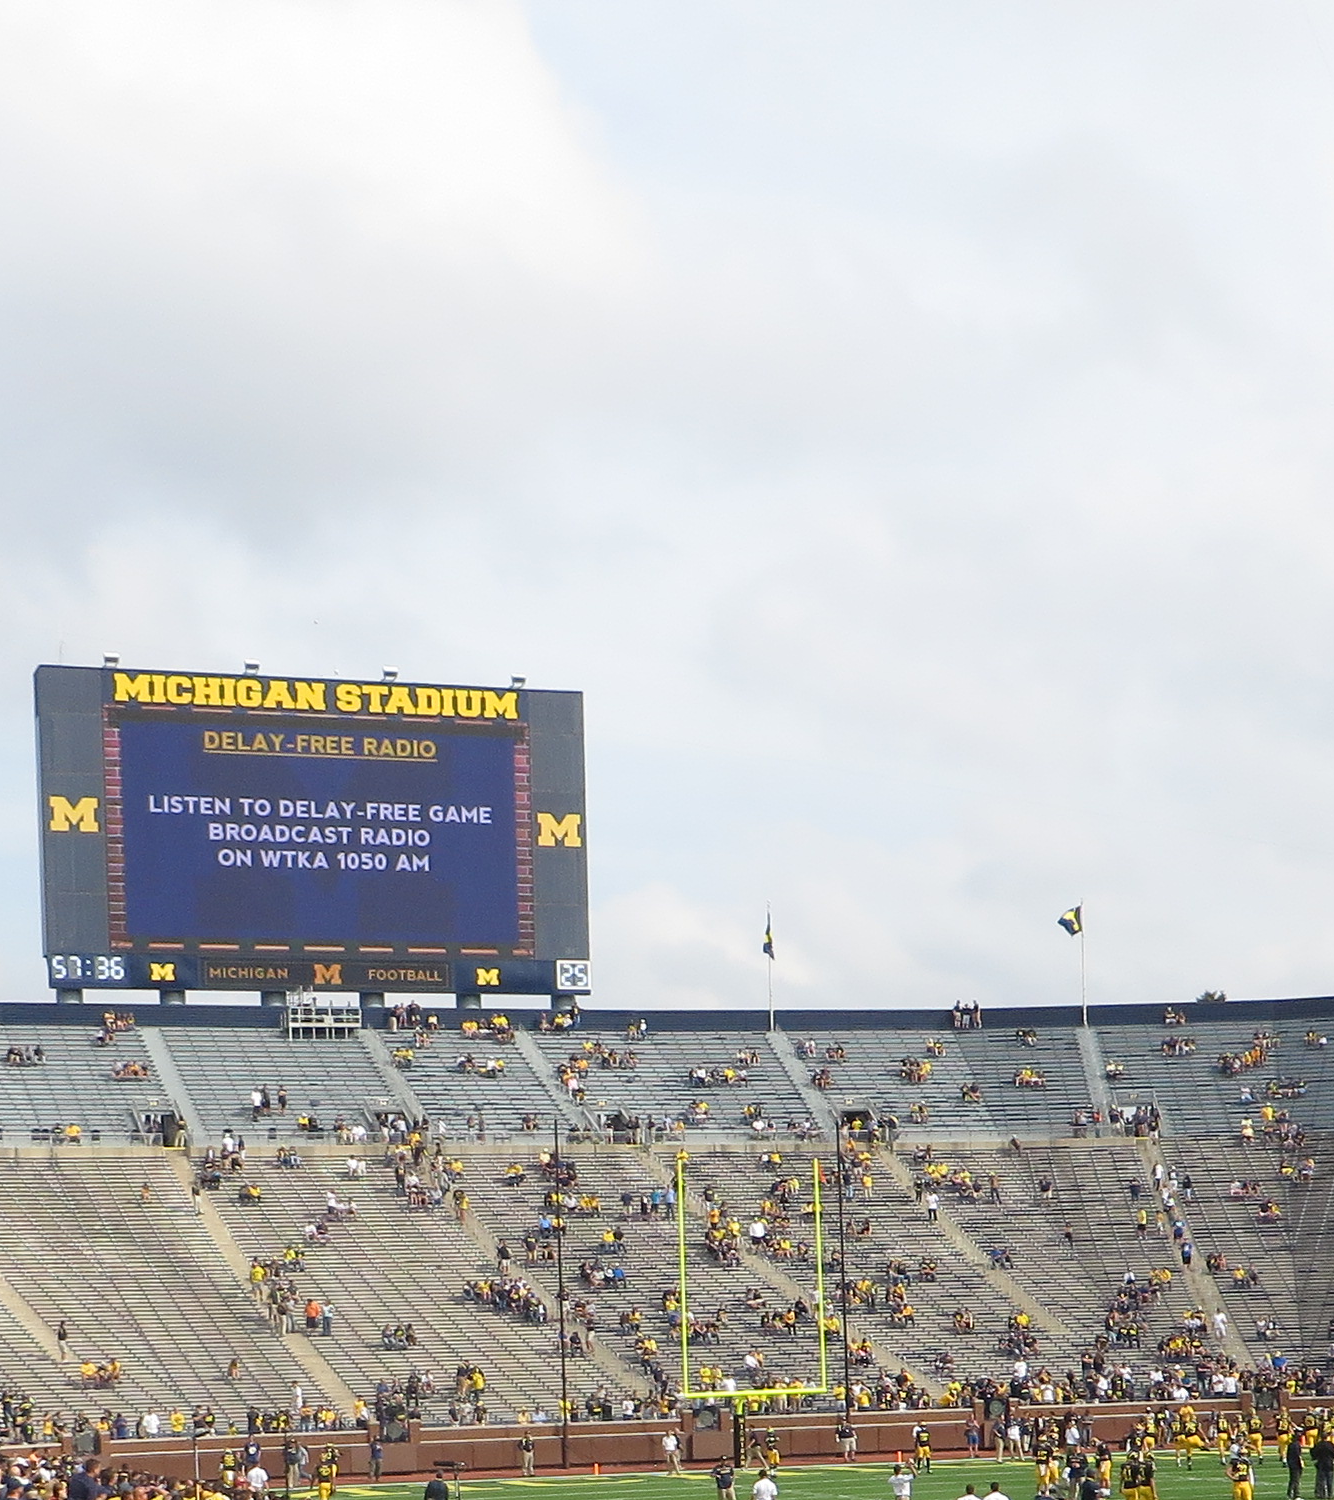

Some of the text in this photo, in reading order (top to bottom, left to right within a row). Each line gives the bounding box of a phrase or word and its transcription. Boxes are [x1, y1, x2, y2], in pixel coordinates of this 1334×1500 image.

[112, 672, 519, 720] MICHIGAN STADIUM
[203, 730, 438, 759] DELAY-FREE RADIO
[49, 796, 99, 833] M
[148, 795, 492, 825] LISTEN TO DELAY-FREE GAME
[208, 822, 431, 848] BROADCAST RADIO
[537, 813, 582, 848] M
[218, 848, 431, 873] ON WTKA 1050 AM
[51, 954, 126, 981] 57:36
[149, 962, 176, 982] M
[208, 963, 443, 985] MICHIGAN M FOOTBALL
[475, 967, 501, 986] M
[560, 963, 588, 986] 25
